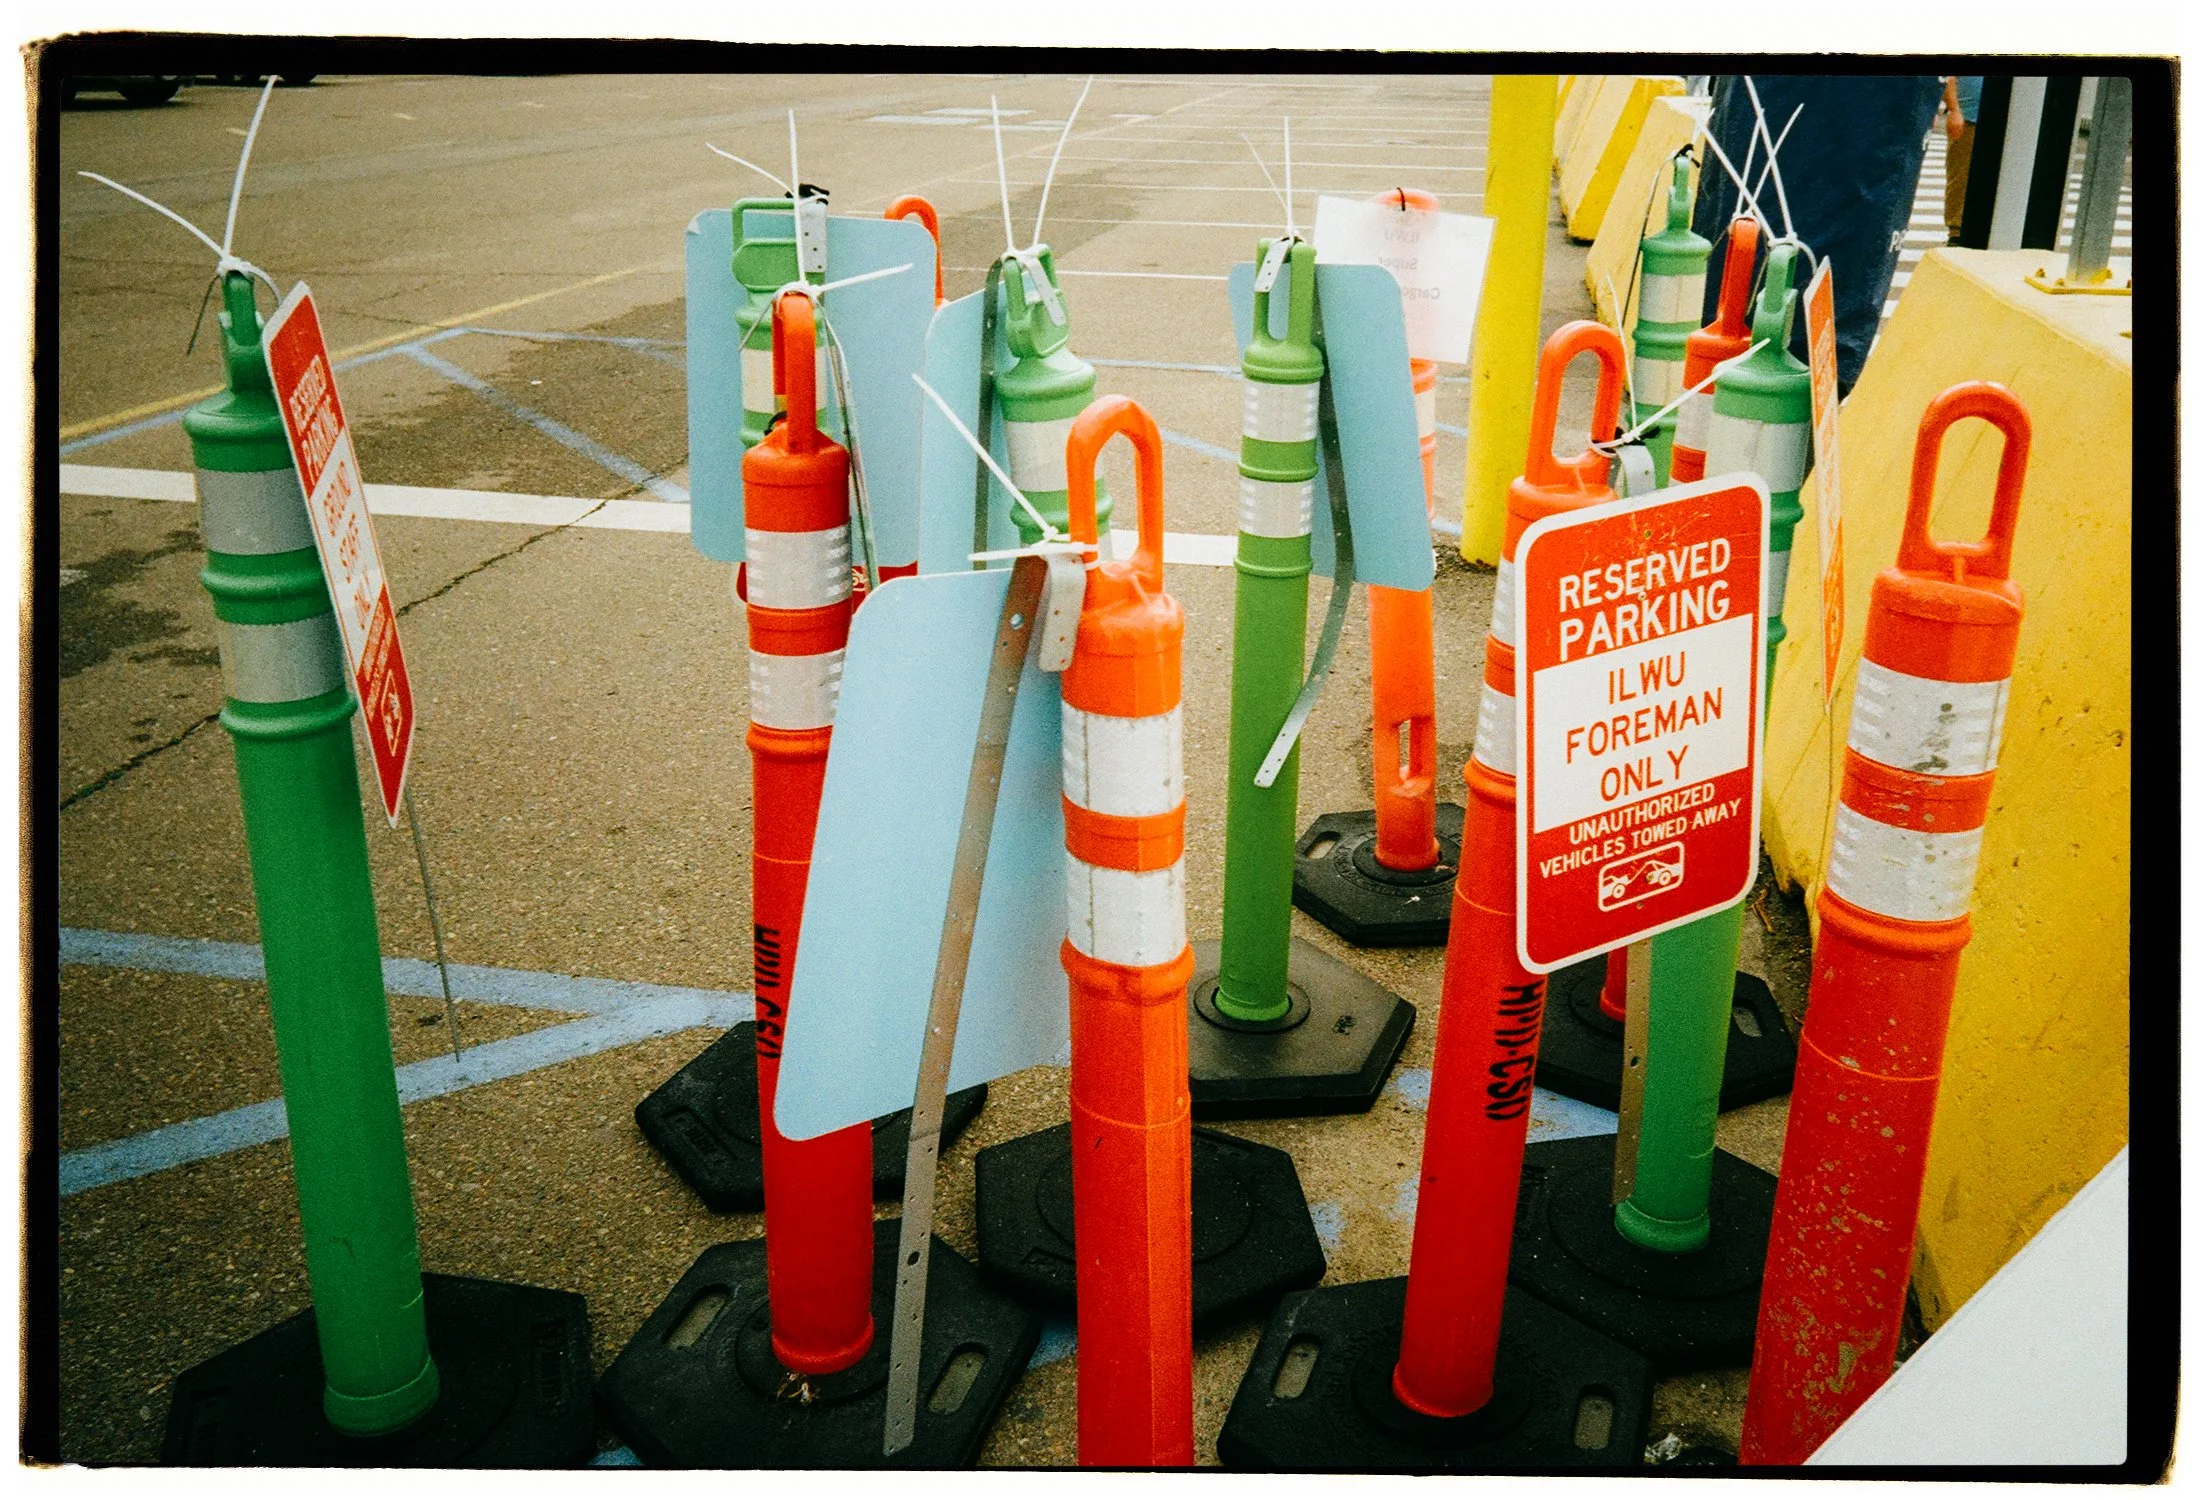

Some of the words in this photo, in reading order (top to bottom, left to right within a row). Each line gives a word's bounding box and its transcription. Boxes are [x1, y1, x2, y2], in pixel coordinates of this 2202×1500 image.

[289, 354, 327, 437] RESERVED
[302, 394, 340, 487] PARKING
[1559, 537, 1731, 613] RESERVED
[1560, 580, 1730, 663] PARKING
[1608, 651, 1685, 704] ILWU
[1566, 687, 1723, 764] FOREMAN
[1600, 745, 1689, 803] ONLY
[1540, 836, 1625, 878] VEHICLES
[1631, 816, 1688, 849] TOWED
[1691, 798, 1741, 829] AWAY
[1569, 783, 1715, 845] UNAUTHORIZED
